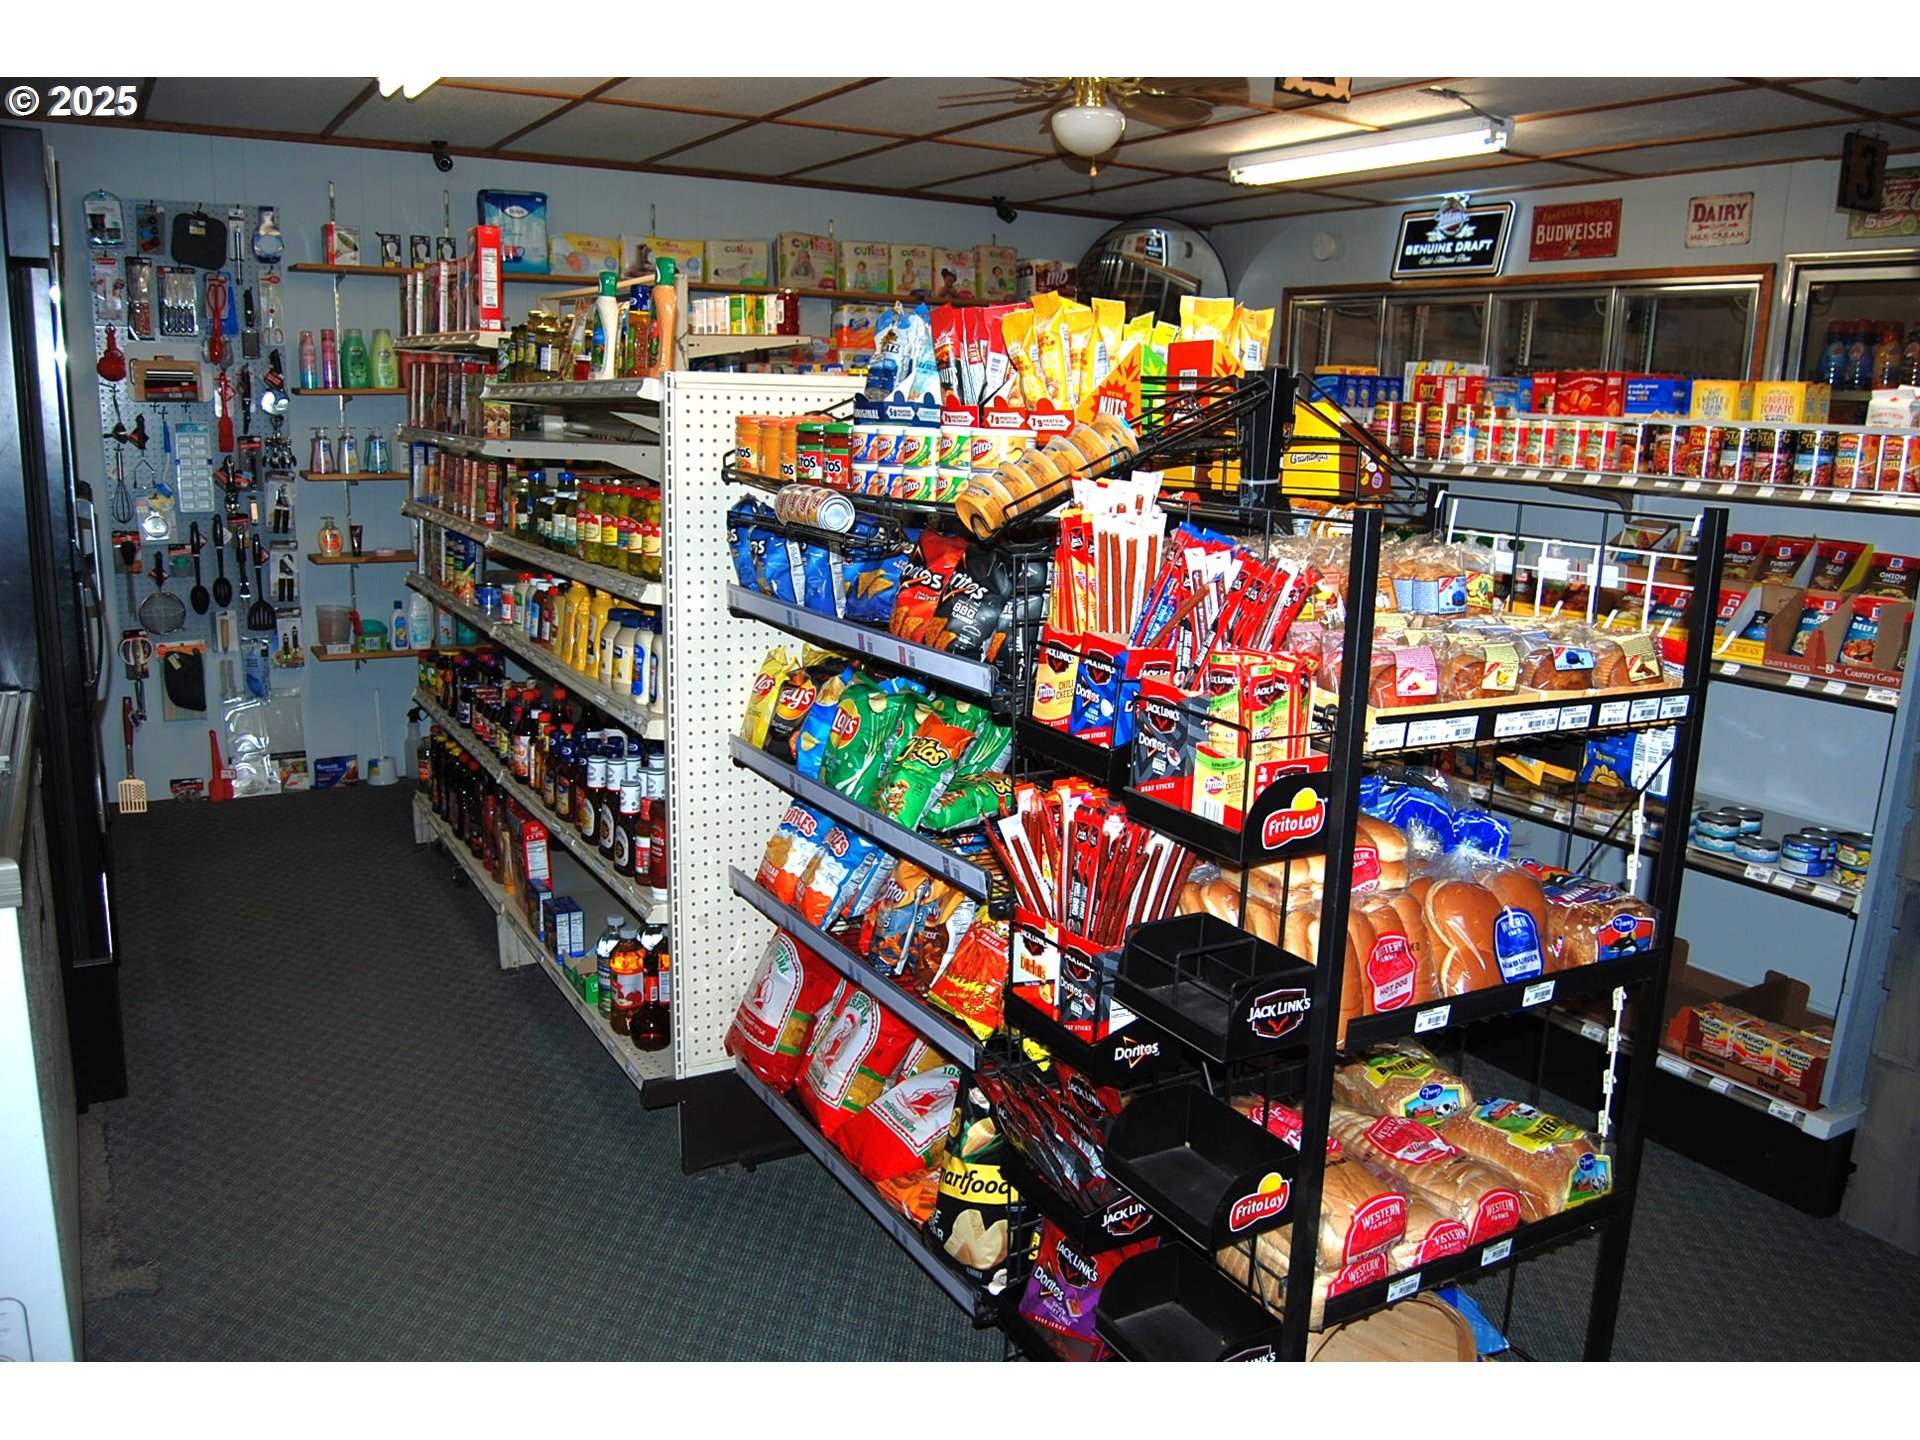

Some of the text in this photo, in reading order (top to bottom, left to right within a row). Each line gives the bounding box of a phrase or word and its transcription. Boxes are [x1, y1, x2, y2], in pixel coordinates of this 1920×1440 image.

[1692, 203, 1748, 223] DAIRY
[1536, 222, 1613, 245] BUDWEISER
[1405, 240, 1493, 256] GENUINE DRAFT
[1099, 396, 1127, 419] NUTS
[1879, 572, 1907, 580] ONION
[953, 601, 976, 619] BBQ
[1852, 622, 1872, 632] BEEF
[1844, 668, 1901, 684] Country Gravy
[1058, 680, 1074, 691] CHILI
[1076, 683, 1099, 703] Doritos
[1145, 702, 1161, 714] JACK
[1139, 732, 1166, 753] Doritos
[1227, 773, 1241, 781] CHILI
[1141, 782, 1175, 793] MEAT STICKS
[982, 933, 1000, 947] FRIES
[1060, 976, 1082, 998] Doritos
[1380, 978, 1408, 996] HOT DOG
[1247, 998, 1311, 1022] JACK LINK'S
[1742, 1032, 1773, 1048] Maruchan
[1115, 1041, 1160, 1060] Doritos
[1758, 1077, 1779, 1091] Beef
[1362, 1203, 1401, 1230] WESTERN
[1486, 1199, 1514, 1217] WESTERN
[1491, 1211, 1509, 1221] FARMS
[1102, 1211, 1129, 1227] JACK
[1369, 1216, 1393, 1231] FARMS
[1056, 1240, 1098, 1282] JACK LINK'S
[1349, 1258, 1380, 1281] WESTERN
[1034, 1266, 1064, 1301] Doritos
